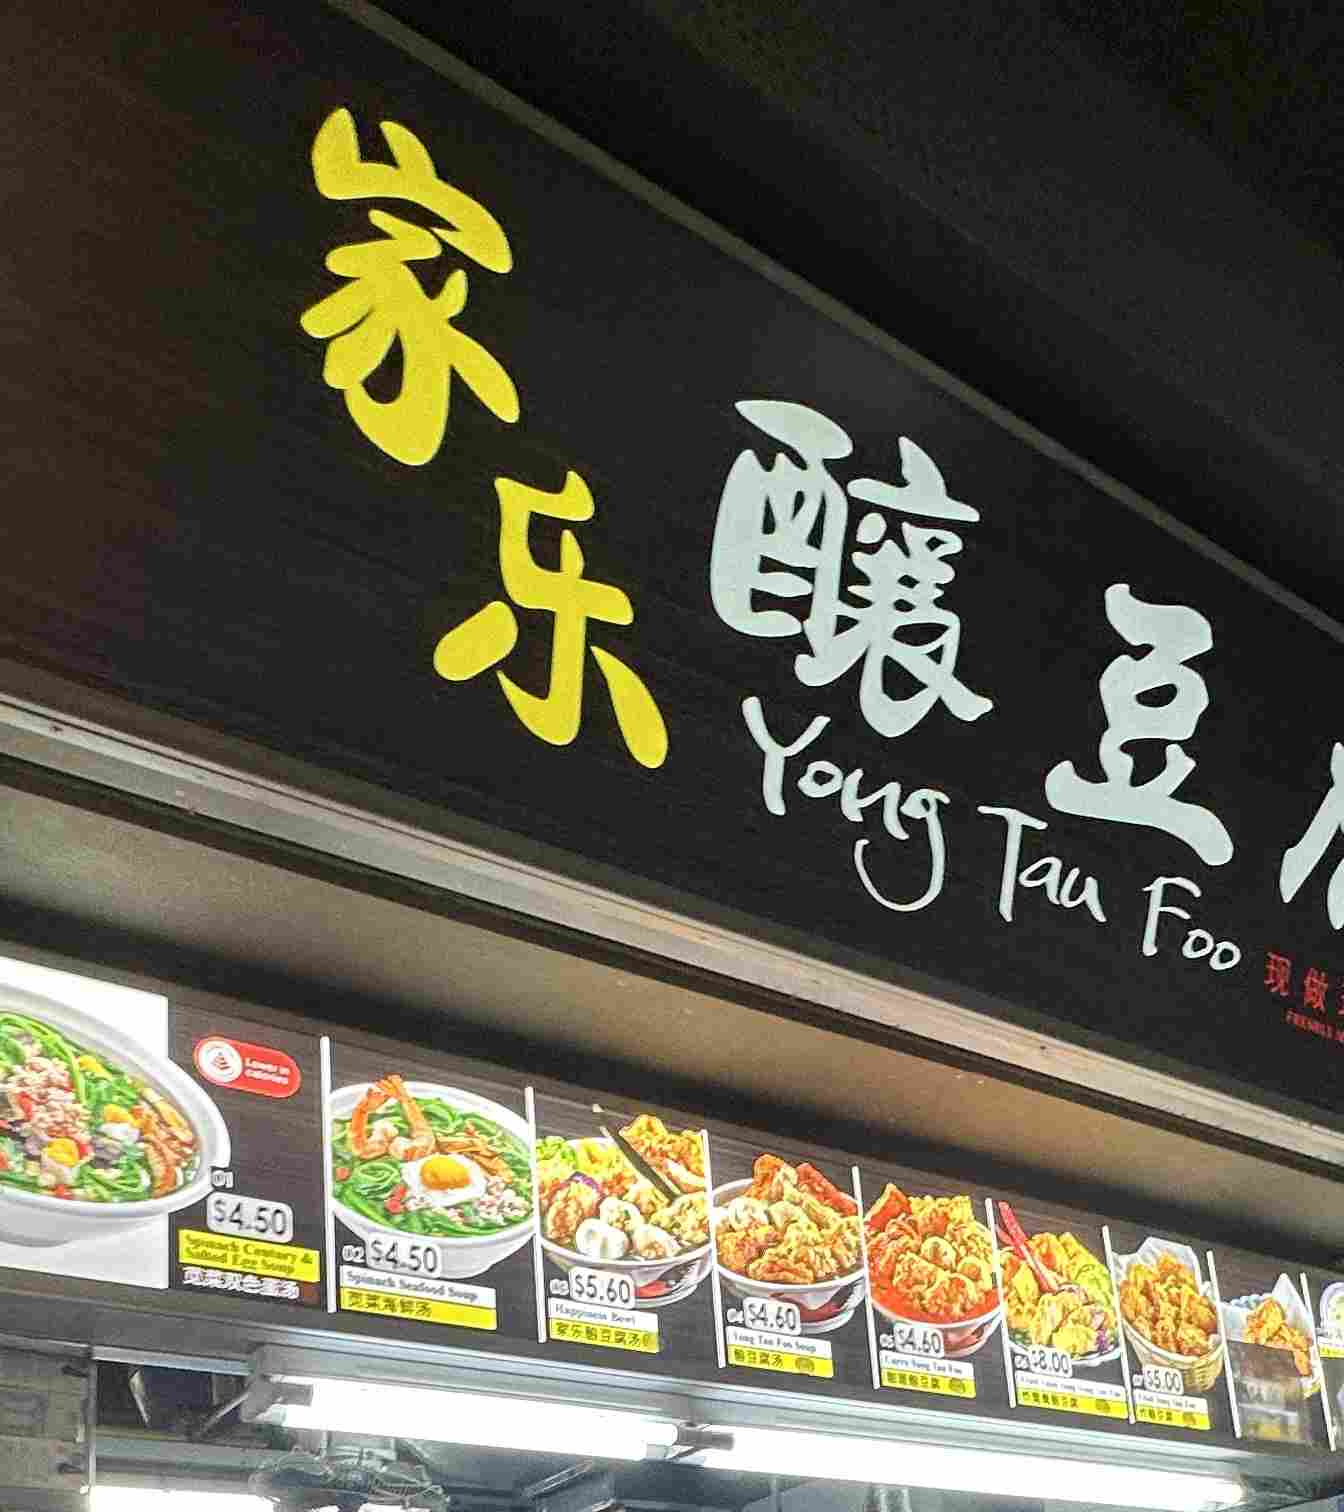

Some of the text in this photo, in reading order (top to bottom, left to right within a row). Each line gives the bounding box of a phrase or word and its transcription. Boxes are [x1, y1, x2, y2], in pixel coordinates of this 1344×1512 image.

[300, 107, 669, 769] 家乐
[741, 695, 1243, 972] Yong Tau Foo
[213, 1200, 287, 1235] $4.50
[184, 1233, 240, 1253] Spinach
[371, 1239, 438, 1273] $4.50
[184, 1247, 296, 1275] Salted Egg Soup
[346, 1270, 397, 1289] Spinach
[447, 1287, 479, 1303] Soup
[574, 1273, 631, 1304] $5.60
[555, 1303, 637, 1326] Happiness Bowl
[747, 1302, 797, 1331] $4.60
[896, 1327, 942, 1354] $4.60
[1031, 1349, 1070, 1375] $8.00
[1145, 1369, 1182, 1393] $5.00
